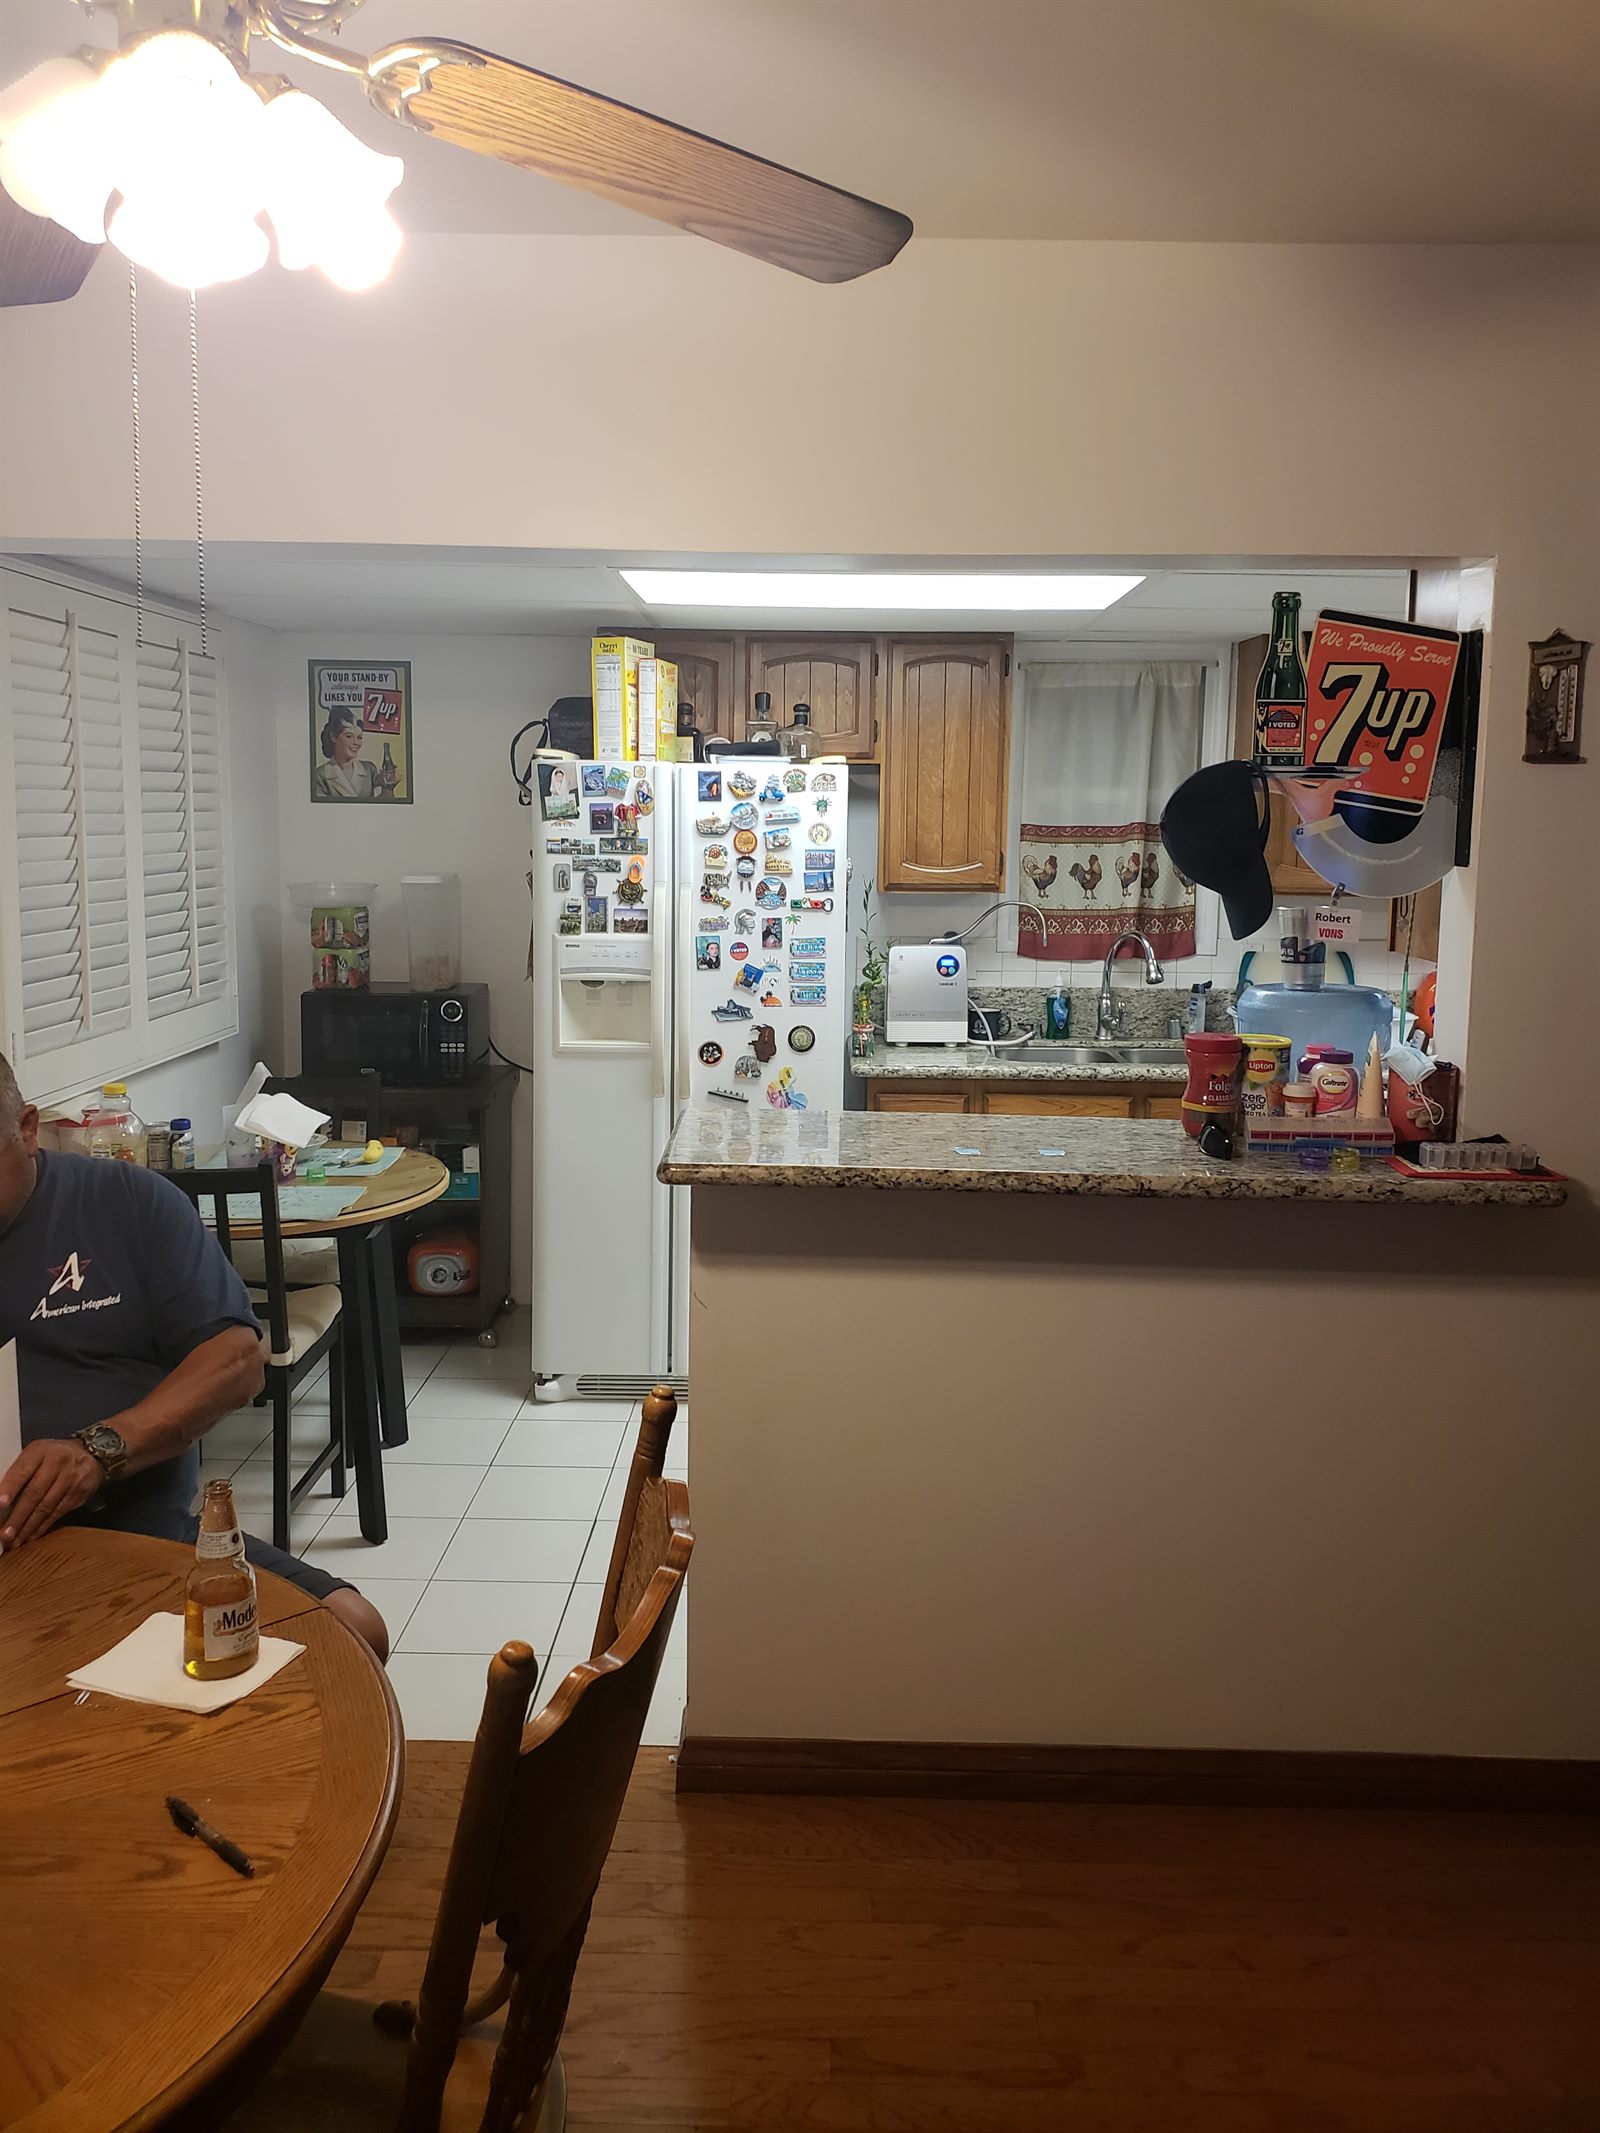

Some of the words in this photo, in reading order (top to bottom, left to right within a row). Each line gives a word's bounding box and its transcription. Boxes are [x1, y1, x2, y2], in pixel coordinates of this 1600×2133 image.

[1321, 629, 1343, 647] We
[1348, 632, 1406, 661] Proudly
[1410, 646, 1451, 665] Serve
[327, 673, 349, 682] YOUR
[352, 673, 388, 682] STAND-BY
[324, 693, 345, 702] LIKES
[347, 693, 363, 702] YOU
[1315, 912, 1352, 924] Robert
[1318, 928, 1344, 939] VONS
[1249, 1062, 1274, 1070] Lipton
[1208, 1081, 1232, 1093] Folg
[1322, 1078, 1348, 1087] Caltrate
[1241, 1093, 1267, 1105] zero
[30, 1297, 80, 1321] American
[82, 1292, 121, 1311] Integrated
[223, 1604, 256, 1630] Mode
